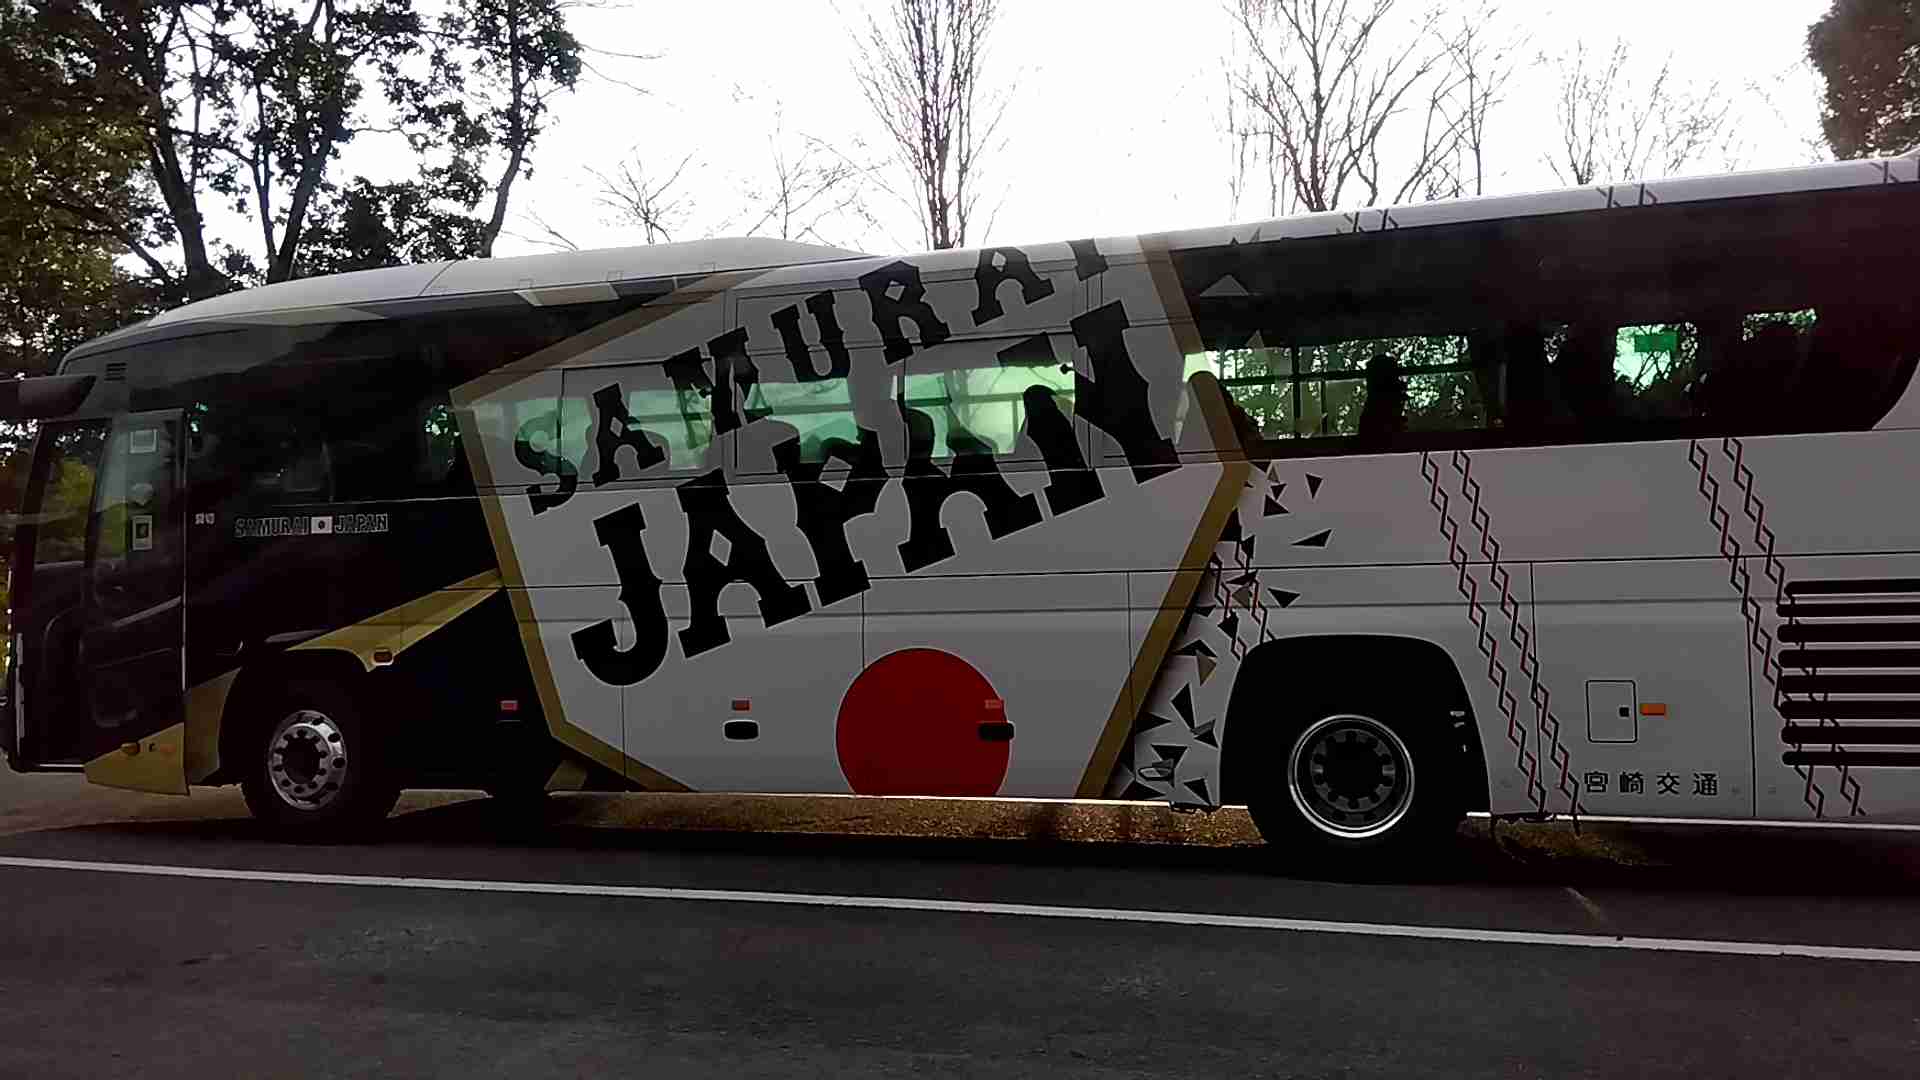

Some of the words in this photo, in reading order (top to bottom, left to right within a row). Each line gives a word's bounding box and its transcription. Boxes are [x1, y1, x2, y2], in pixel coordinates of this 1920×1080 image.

[514, 238, 1108, 516] SAMURAI
[234, 516, 310, 537] SAMURAI
[335, 513, 389, 533] JAPAN
[571, 300, 1183, 686] JAPAN
[1584, 771, 1719, 796] 宮崎交通
